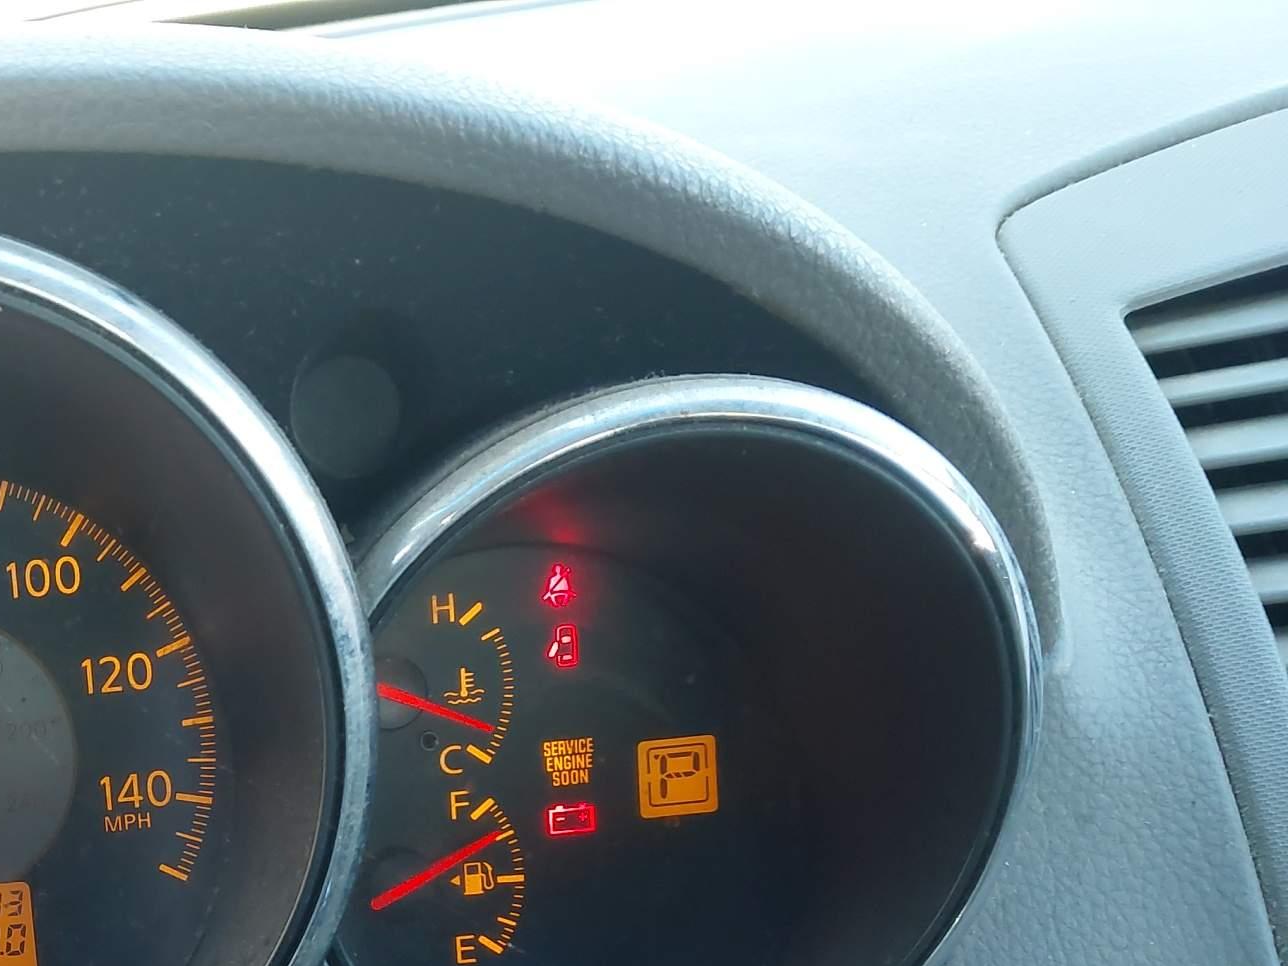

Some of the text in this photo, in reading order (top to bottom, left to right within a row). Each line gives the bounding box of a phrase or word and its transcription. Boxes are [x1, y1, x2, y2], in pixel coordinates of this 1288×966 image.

[6, 556, 81, 598] 100
[431, 592, 456, 625] H
[81, 652, 153, 695] 120
[439, 744, 463, 775] C
[543, 737, 594, 757] SERVICE
[546, 753, 593, 772] ENGINE
[100, 770, 172, 811] 140
[552, 768, 589, 787] SOON
[450, 790, 470, 820] F
[103, 812, 152, 832] MPH
[455, 934, 477, 965] E
